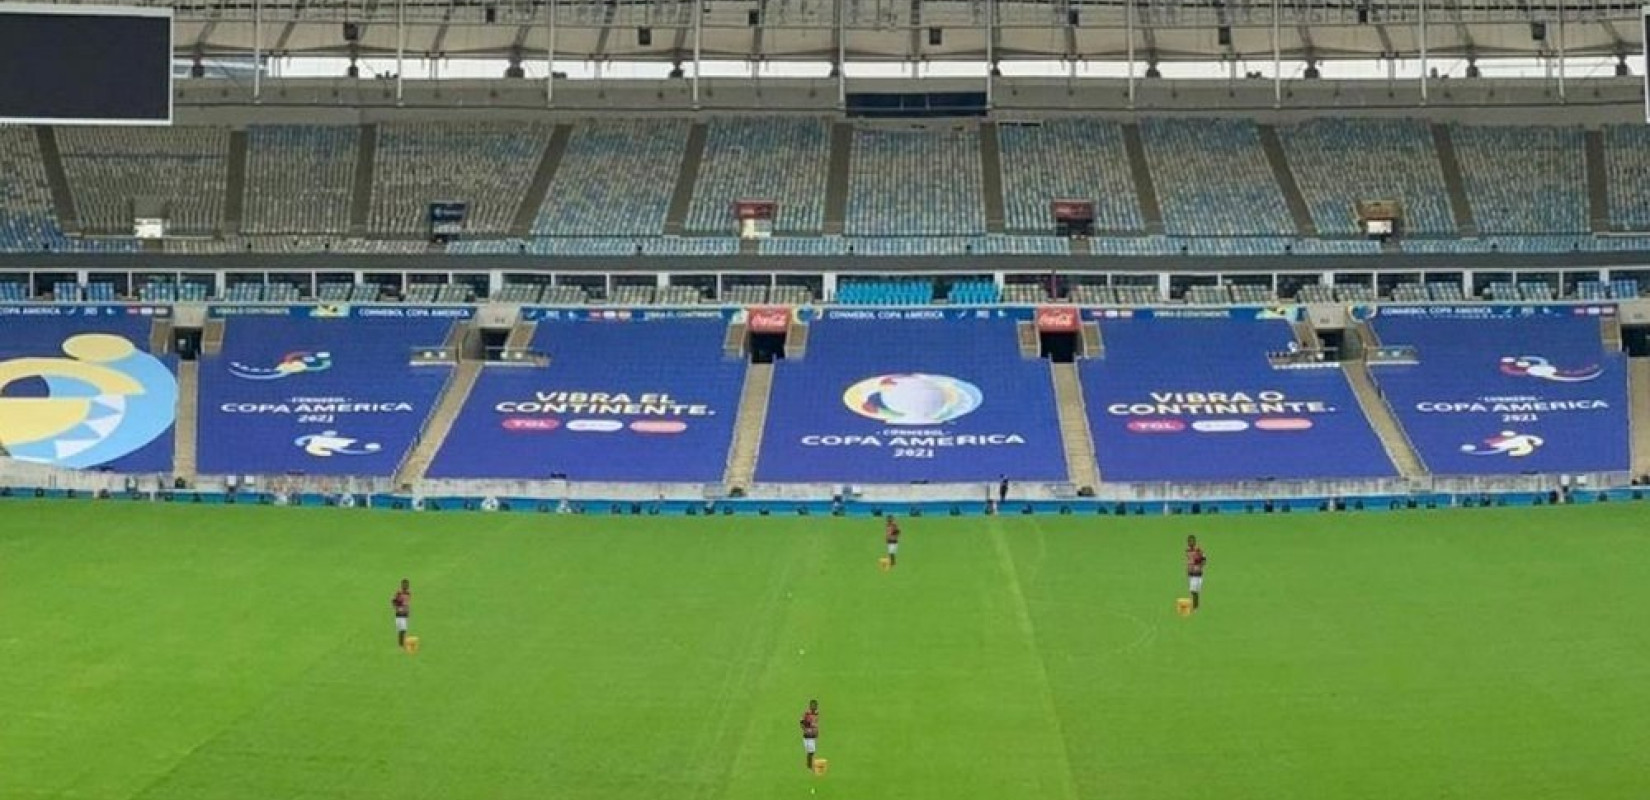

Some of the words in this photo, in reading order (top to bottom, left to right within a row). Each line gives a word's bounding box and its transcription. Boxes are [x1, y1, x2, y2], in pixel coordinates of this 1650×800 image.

[405, 308, 429, 317] COPA
[431, 308, 469, 317] AMERICA
[829, 310, 876, 319] CONMEBOL
[877, 310, 902, 319] COPA
[904, 310, 944, 319] AMERICA
[1381, 306, 1427, 316] CONMEBOL
[1428, 306, 1452, 315] COPA
[1454, 306, 1491, 314] AMERICA
[536, 391, 632, 403] VIBRA
[640, 393, 676, 404] EL
[1150, 391, 1253, 403] VIBRA
[1258, 390, 1285, 402] O
[221, 402, 291, 413] COPA
[294, 402, 414, 413] AMERICA
[495, 401, 717, 416] CONTINENTE.
[1108, 401, 1337, 416] CONTINENTE.
[1416, 401, 1487, 413] COPA
[1493, 399, 1610, 413] AMERICA
[801, 435, 882, 447] COPA
[888, 433, 1026, 447] AMERICA
[893, 448, 935, 458] 2021
